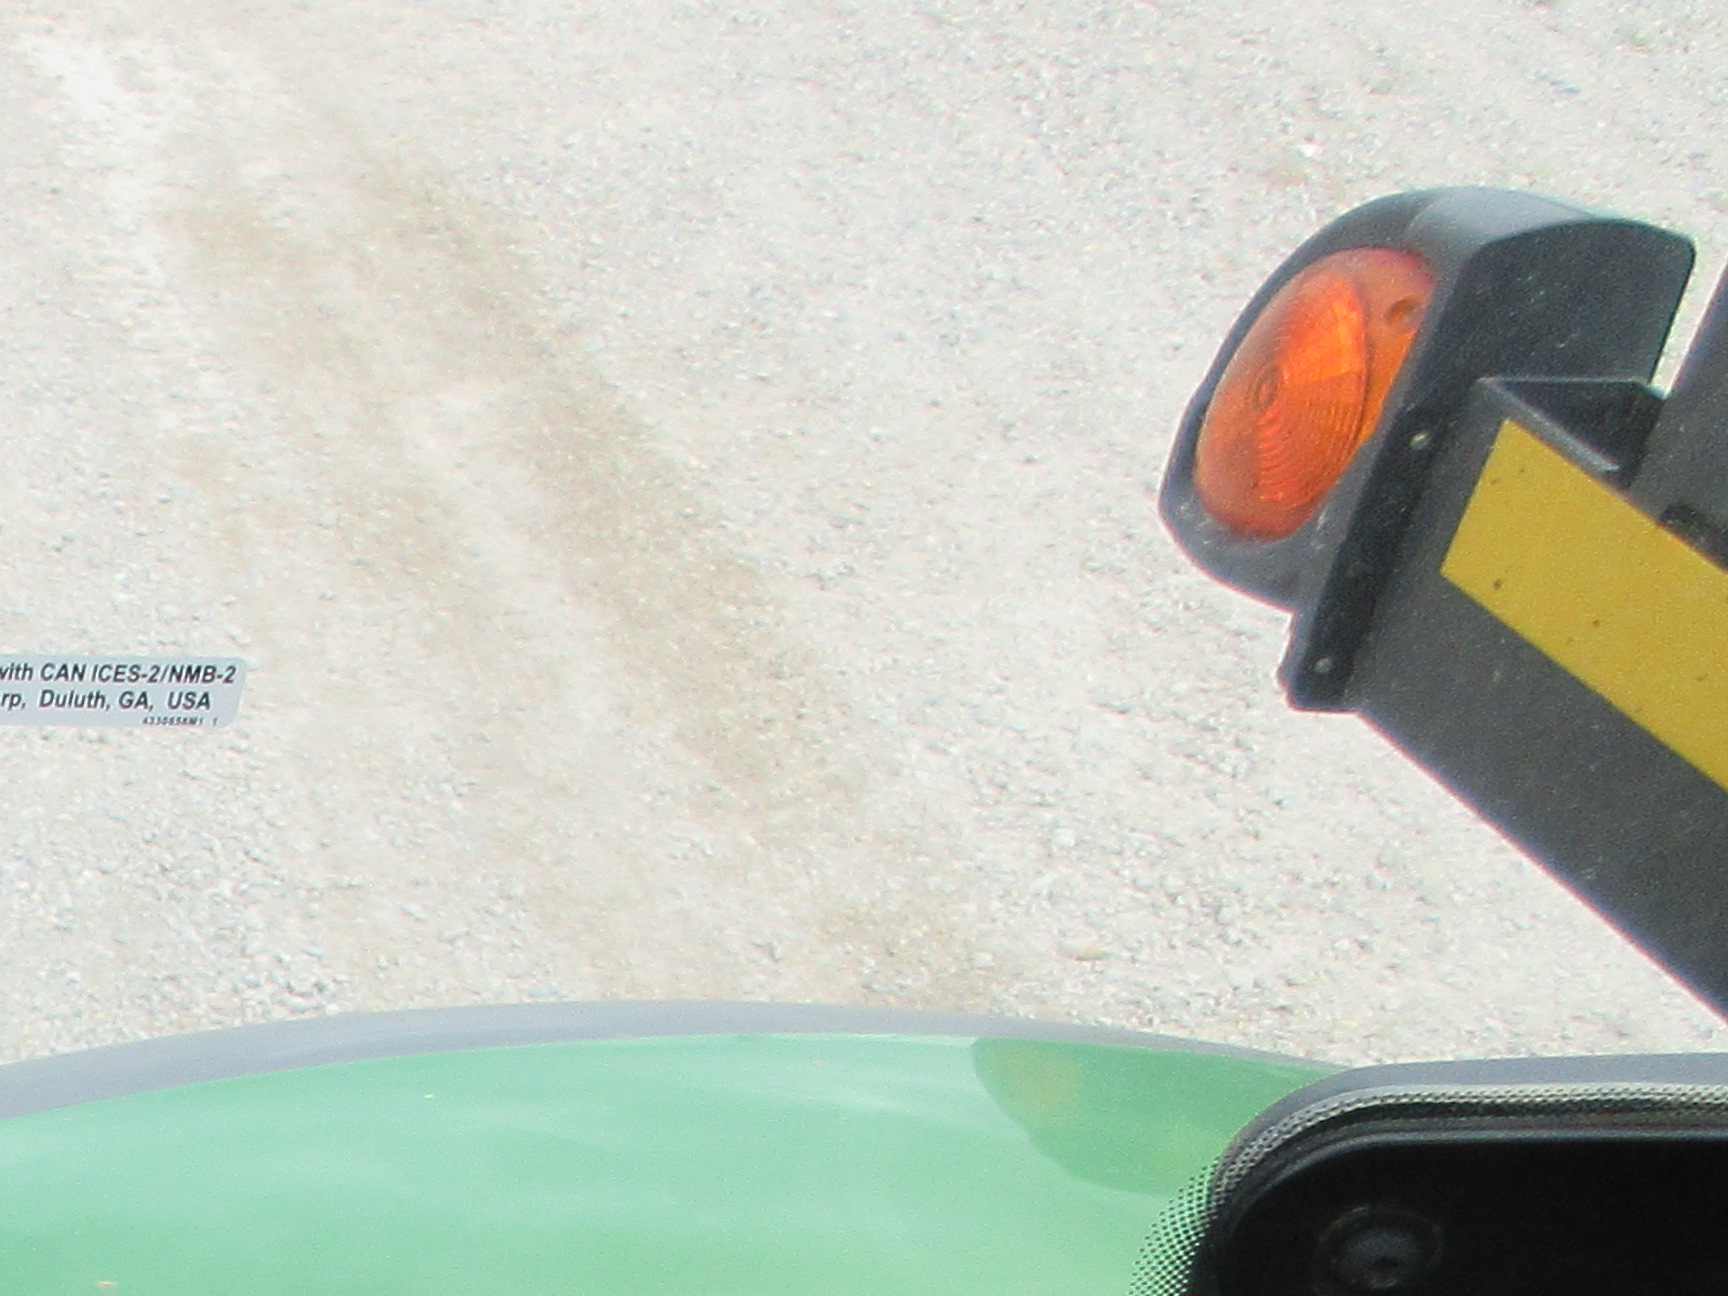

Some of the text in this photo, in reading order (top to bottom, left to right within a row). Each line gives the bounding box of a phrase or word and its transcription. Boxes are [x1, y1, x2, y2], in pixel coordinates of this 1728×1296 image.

[40, 662, 87, 682] CAN
[91, 663, 237, 684] ICES-2/NMB-2
[38, 688, 111, 712] Duluth,
[118, 690, 154, 712] GA,
[167, 691, 211, 710] USA
